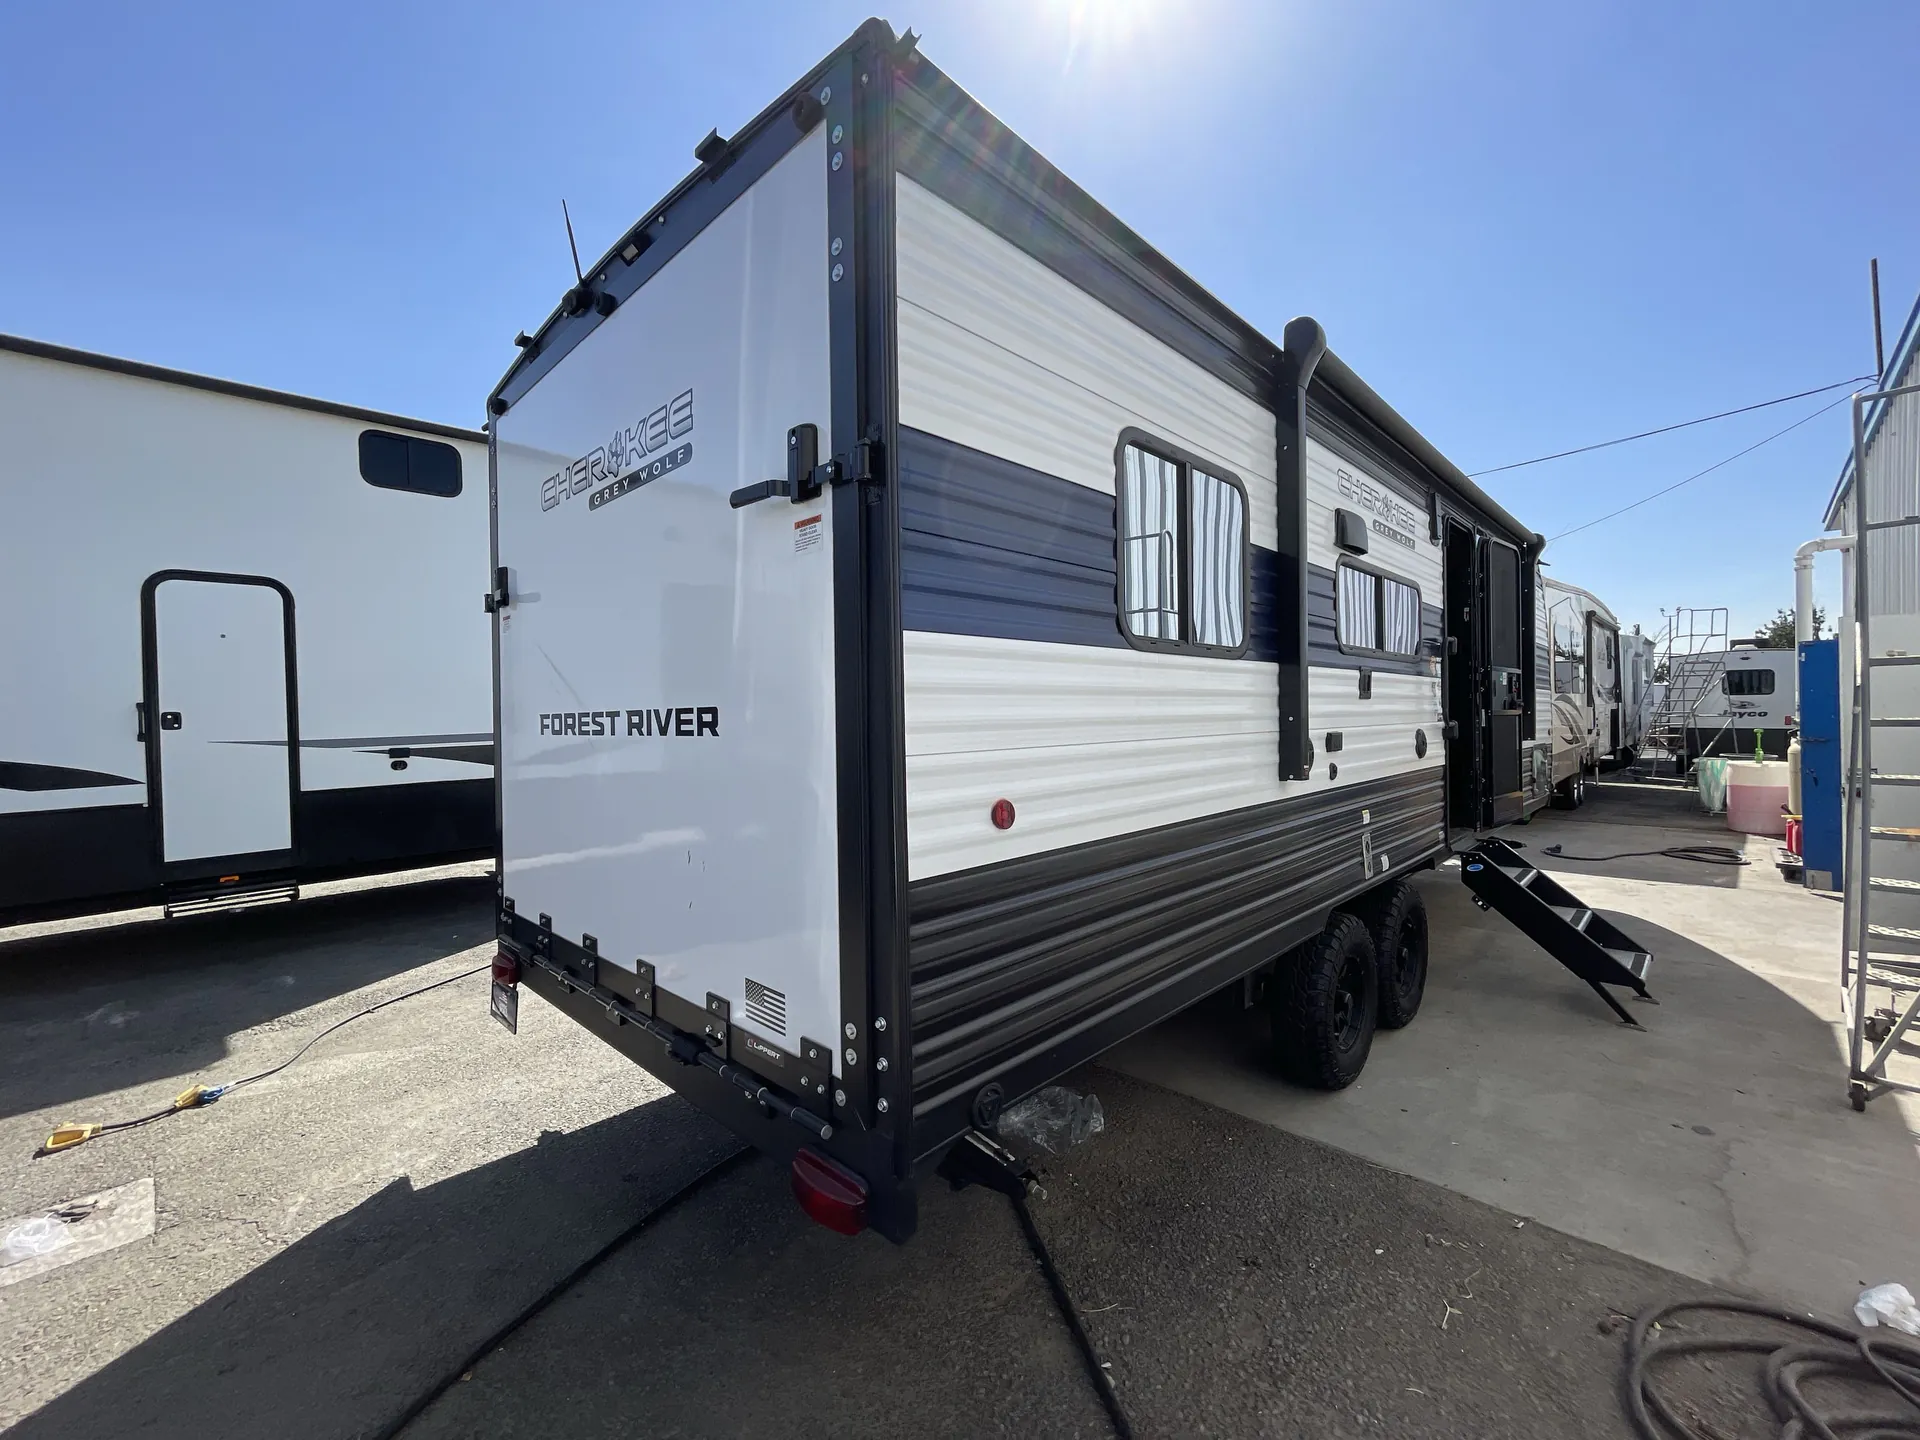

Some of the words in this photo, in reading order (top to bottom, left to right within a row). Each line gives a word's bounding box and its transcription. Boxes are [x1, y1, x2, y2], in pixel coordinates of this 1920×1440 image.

[593, 477, 630, 505] GREY
[638, 448, 684, 481] WOLF
[1375, 522, 1394, 537] GREY
[1396, 532, 1414, 546] WOLF
[539, 710, 621, 736] FOREST
[625, 706, 720, 737] RIVER
